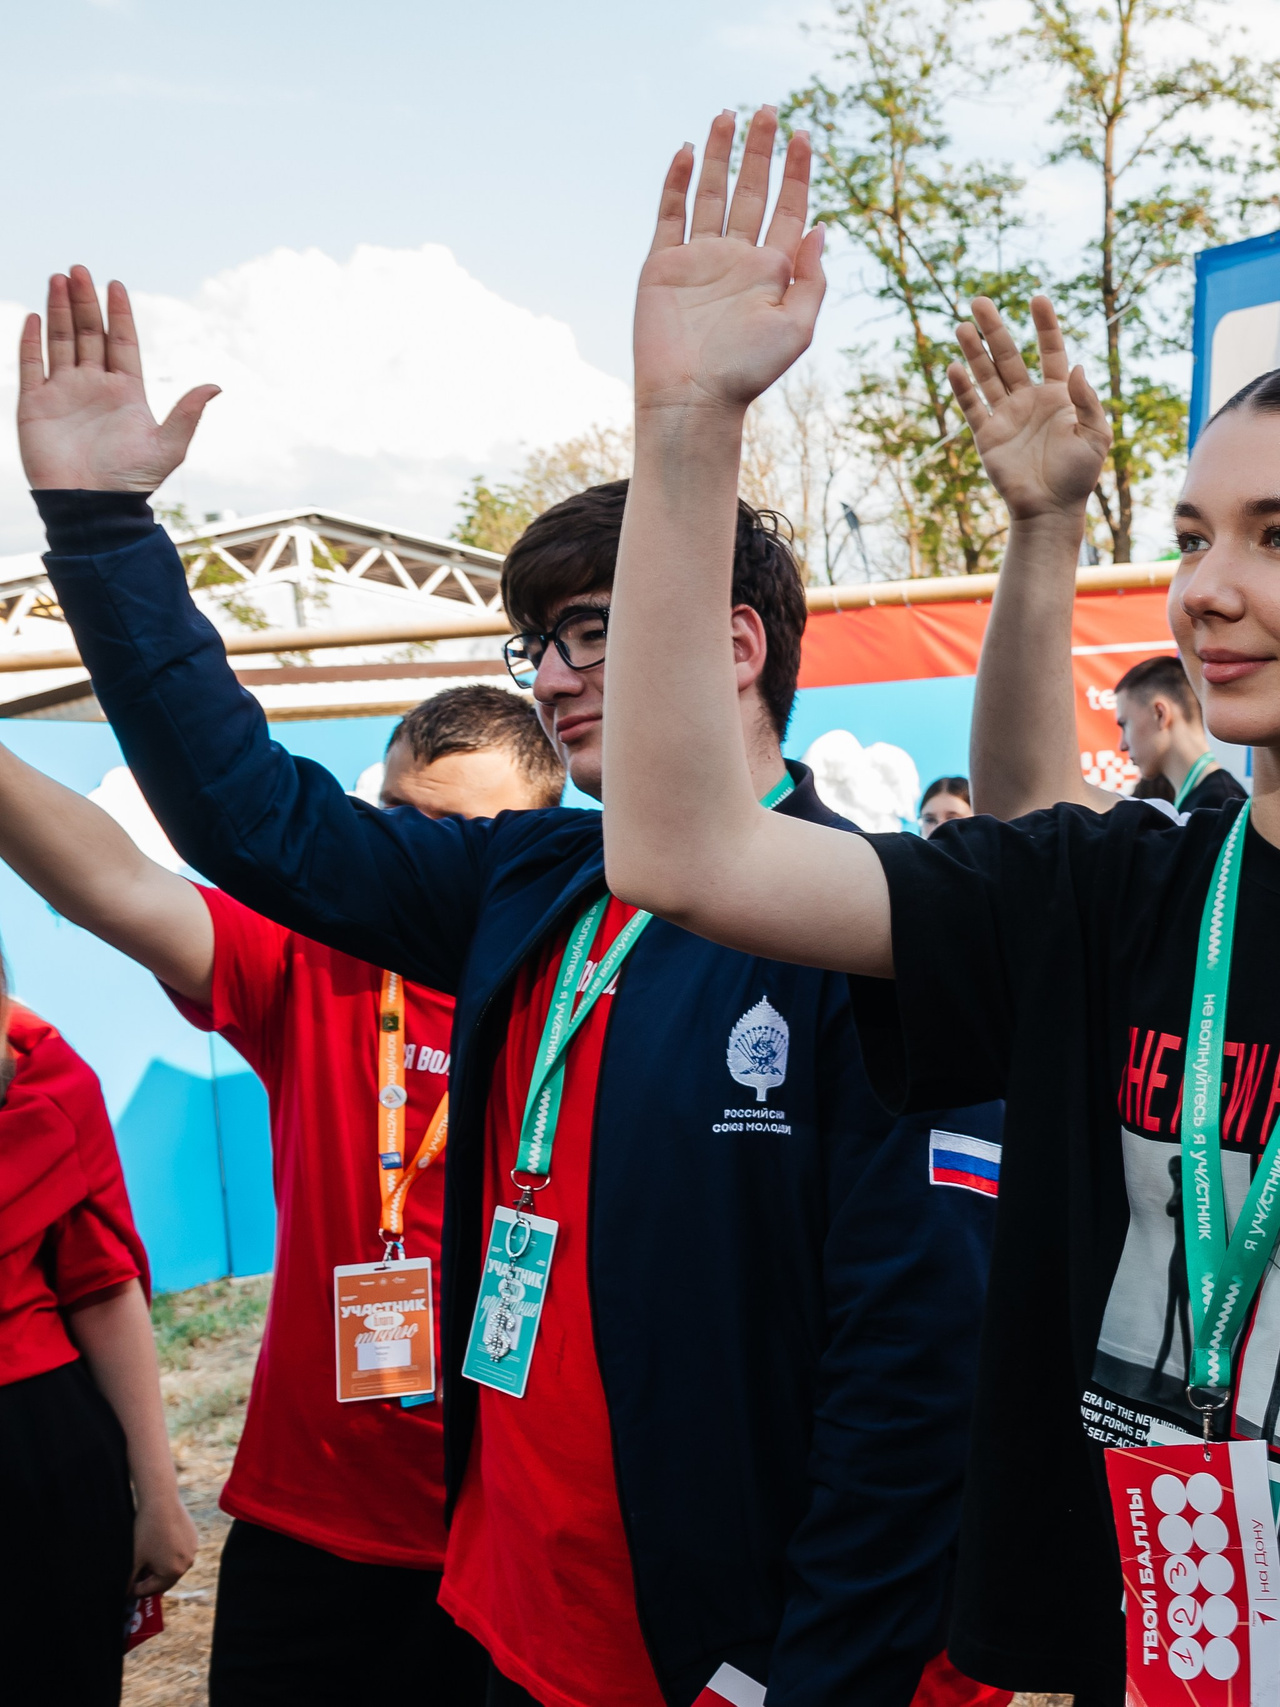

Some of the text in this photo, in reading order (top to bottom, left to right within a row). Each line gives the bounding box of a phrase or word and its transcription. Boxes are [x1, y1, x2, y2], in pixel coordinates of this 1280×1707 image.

[1202, 993, 1216, 1016] не
[1192, 1019, 1213, 1127] волнуйтесь
[712, 1122, 744, 1133] СОЮЗ
[1193, 1134, 1206, 1144] я
[1244, 1239, 1258, 1251] я
[340, 1298, 427, 1319] УЧАСТНИК
[1082, 1391, 1103, 1408] ERA
[1104, 1399, 1117, 1412] OF
[1117, 1405, 1136, 1421] THE
[1102, 1416, 1134, 1436] FORMS
[1251, 1519, 1270, 1592] на Дону
[1126, 1488, 1160, 1665] ТВОИ БАЛЛЫ
[1169, 1561, 1197, 1667] 1 2 3
